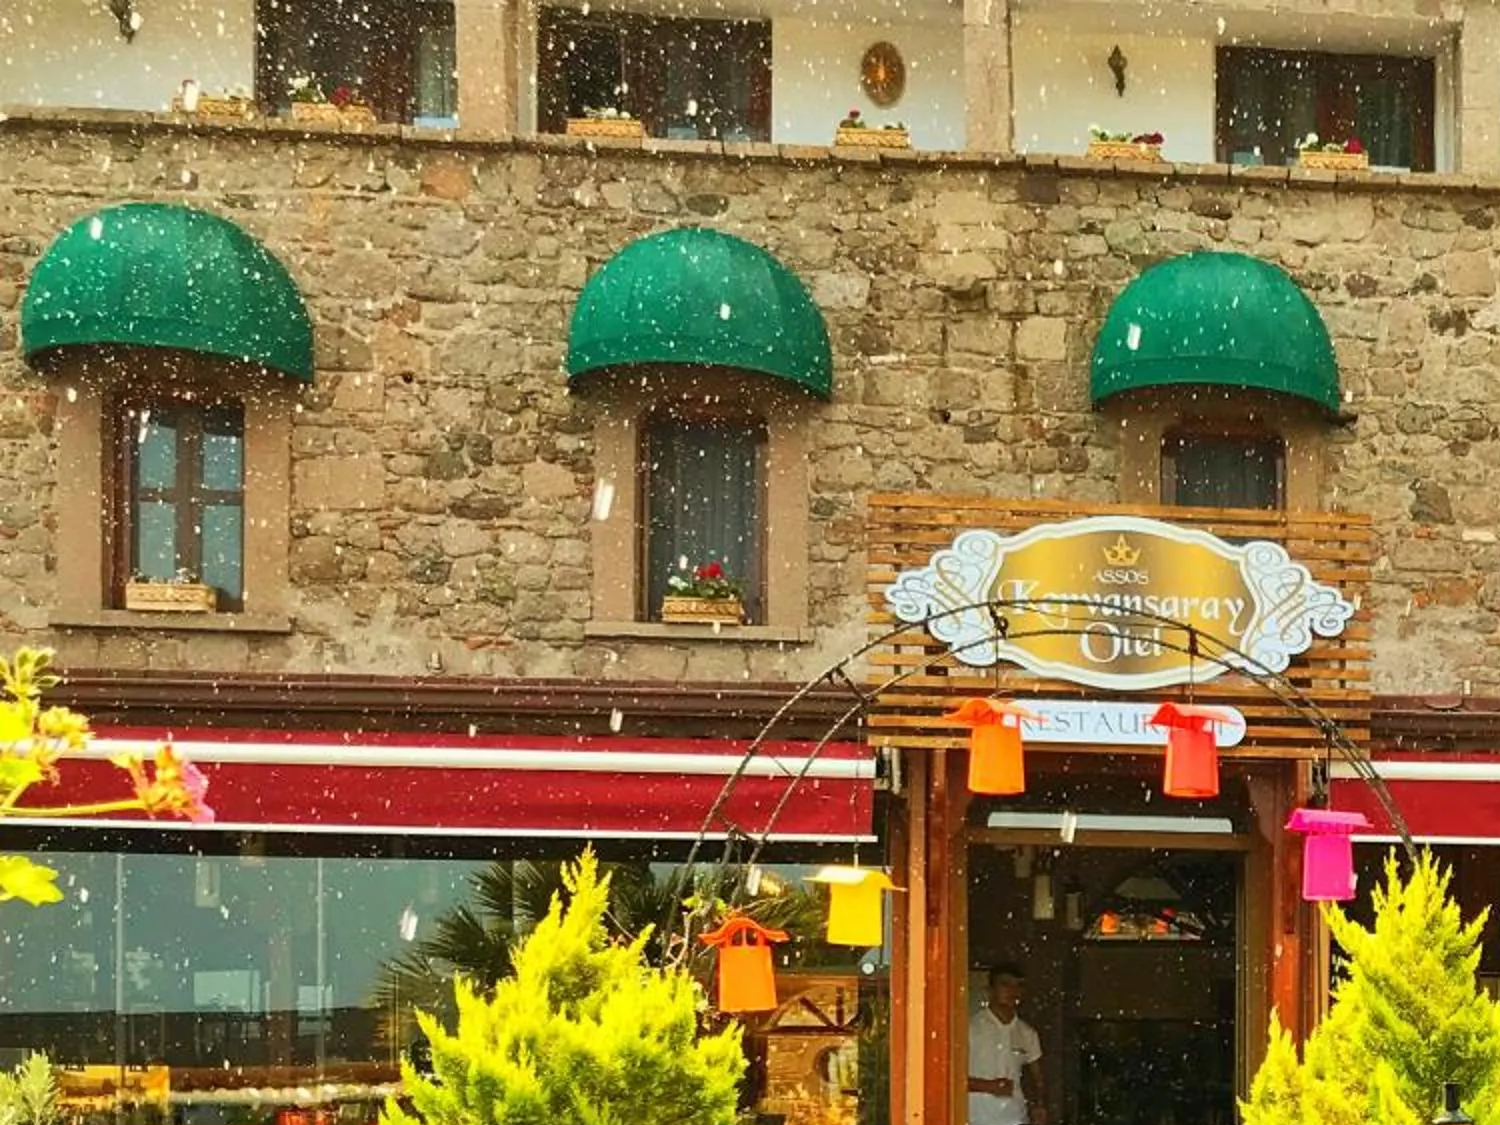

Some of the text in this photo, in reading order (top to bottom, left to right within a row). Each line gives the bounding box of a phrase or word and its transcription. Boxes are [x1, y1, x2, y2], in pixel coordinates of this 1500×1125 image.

[1093, 568, 1150, 585] ASSOS
[997, 579, 1246, 636] Kervansaray
[1080, 620, 1163, 663] Otel
[1016, 709, 1232, 737] ESTAUR
